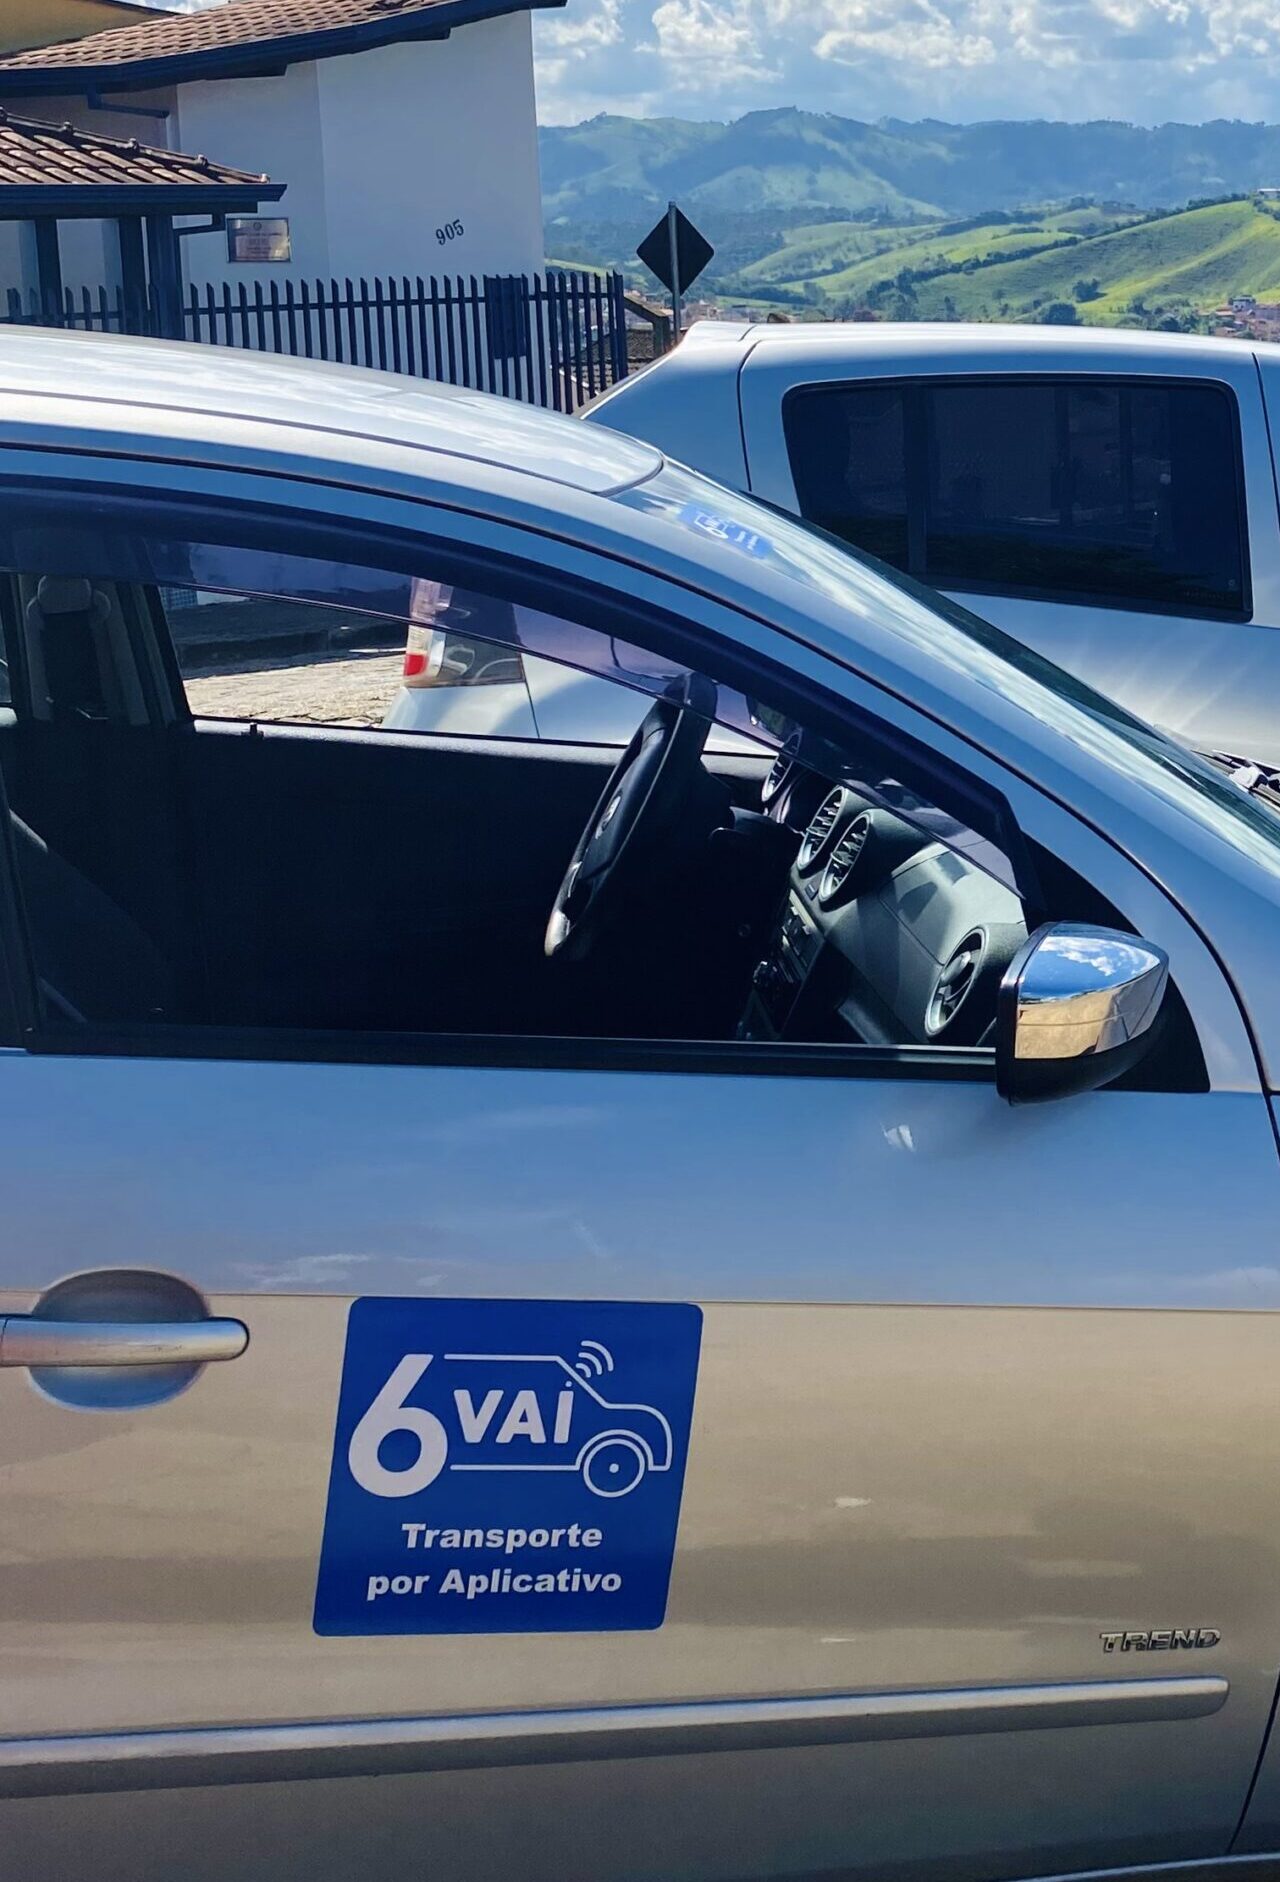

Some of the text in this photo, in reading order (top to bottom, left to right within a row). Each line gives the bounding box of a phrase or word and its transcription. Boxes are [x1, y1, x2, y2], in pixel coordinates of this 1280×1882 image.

[435, 218, 464, 245] 905
[401, 1522, 603, 1554] Transporte
[366, 1568, 622, 1601] por Aplicativo
[1100, 1627, 1221, 1653] TREND
